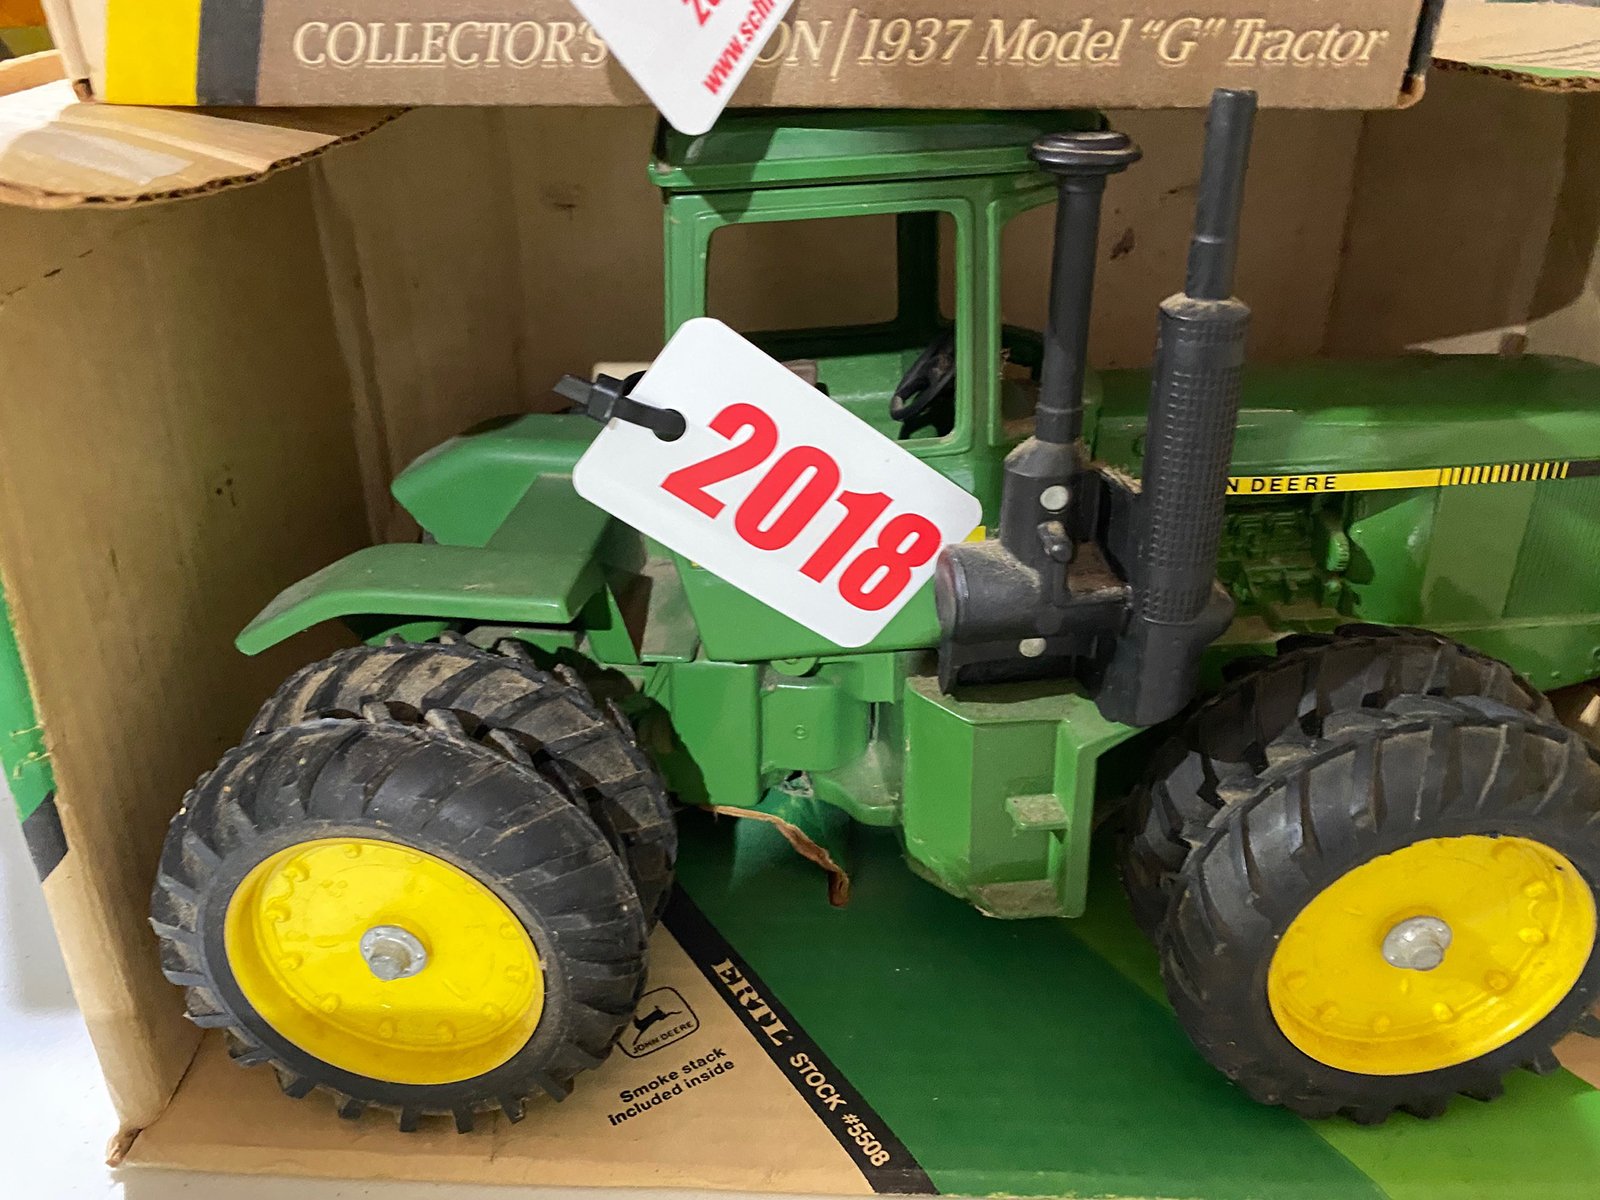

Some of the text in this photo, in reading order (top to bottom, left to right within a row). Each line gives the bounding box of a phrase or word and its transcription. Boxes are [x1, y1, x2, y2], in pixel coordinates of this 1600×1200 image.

[292, 20, 608, 66] COLLECTOR'S
[977, 17, 1134, 65] Model
[1225, 17, 1390, 66] Tractor
[703, 0, 776, 94] www.sch
[660, 402, 942, 611] 2018
[1251, 475, 1337, 493] DEERE
[633, 1020, 694, 1054] JOHN DEERE
[711, 958, 890, 1167] ERTL STOCK #5508
[608, 1060, 735, 1126] included inside
[619, 1047, 727, 1103] Smoke stack
